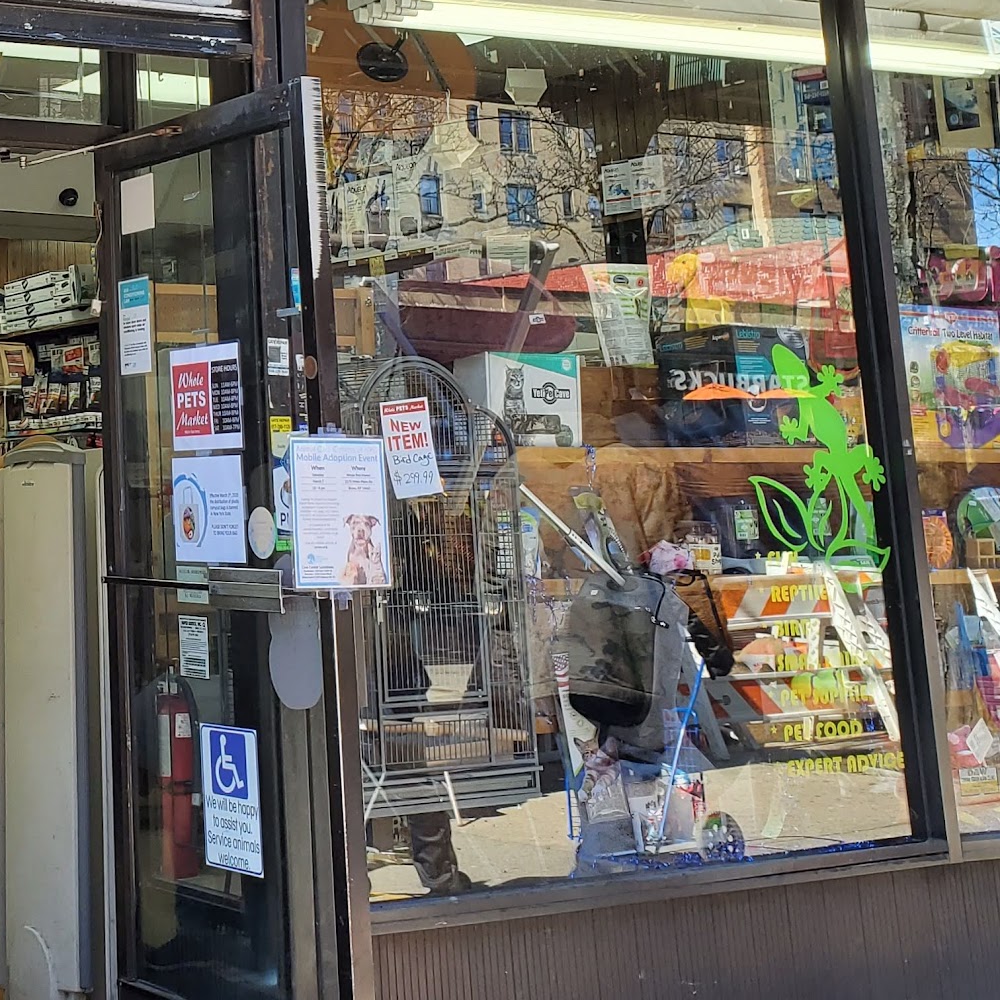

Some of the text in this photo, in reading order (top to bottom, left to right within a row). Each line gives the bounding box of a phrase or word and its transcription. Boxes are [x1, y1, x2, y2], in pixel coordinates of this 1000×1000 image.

[942, 328, 955, 338] Two
[178, 371, 204, 388] Whole
[177, 391, 206, 408] PETS
[177, 410, 209, 430] Market
[390, 419, 421, 432] NEW
[388, 432, 428, 451] ITEM!
[296, 453, 377, 463] Mobile Adoption Event
[787, 751, 906, 777] EXPERT ADVICE
[206, 795, 260, 821] We will be happy
[213, 814, 220, 828] to
[220, 817, 238, 831] assist
[208, 830, 260, 854] Service animals
